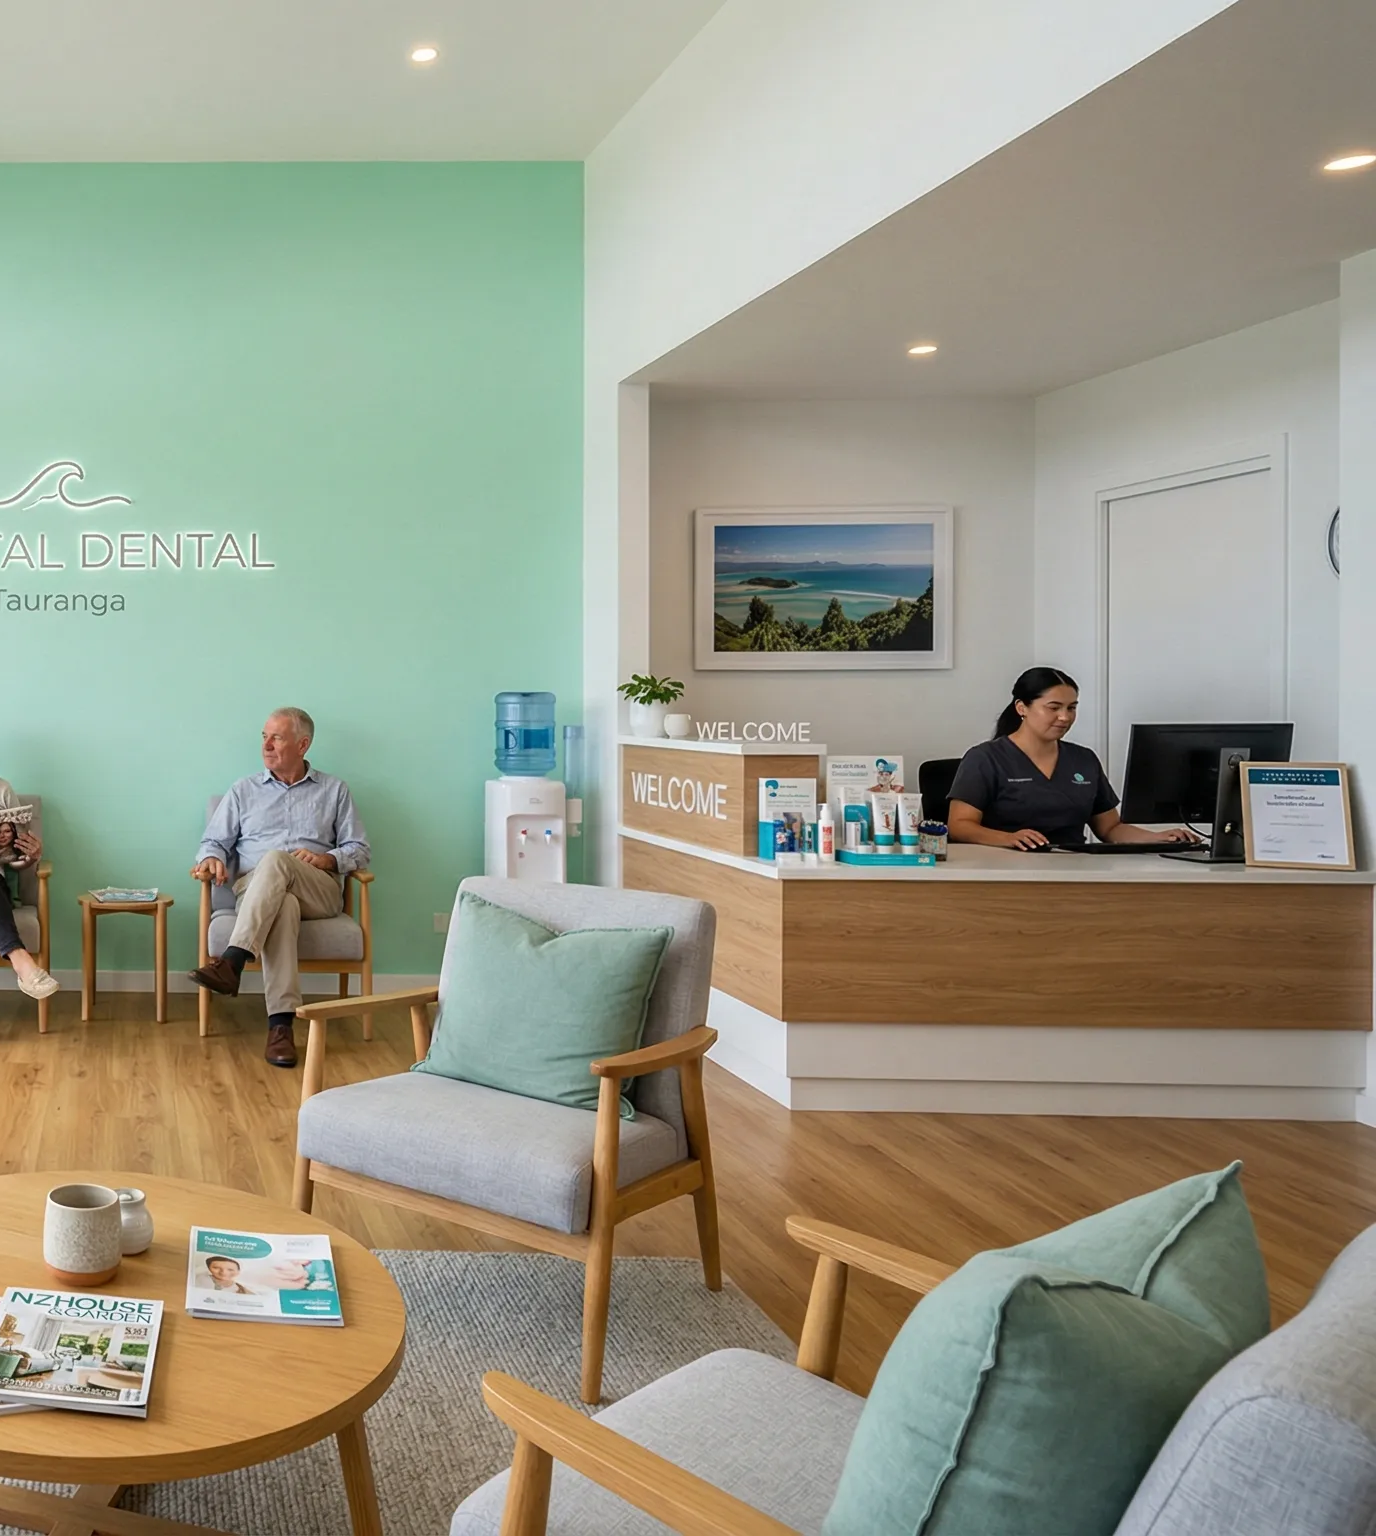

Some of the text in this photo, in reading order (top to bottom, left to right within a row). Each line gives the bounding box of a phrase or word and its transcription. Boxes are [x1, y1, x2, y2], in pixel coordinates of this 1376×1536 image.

[80, 532, 276, 569] DENTAL
[695, 721, 812, 743] WELCOME
[630, 771, 728, 821] WELCOME
[10, 1291, 154, 1315] NZHOUSE
